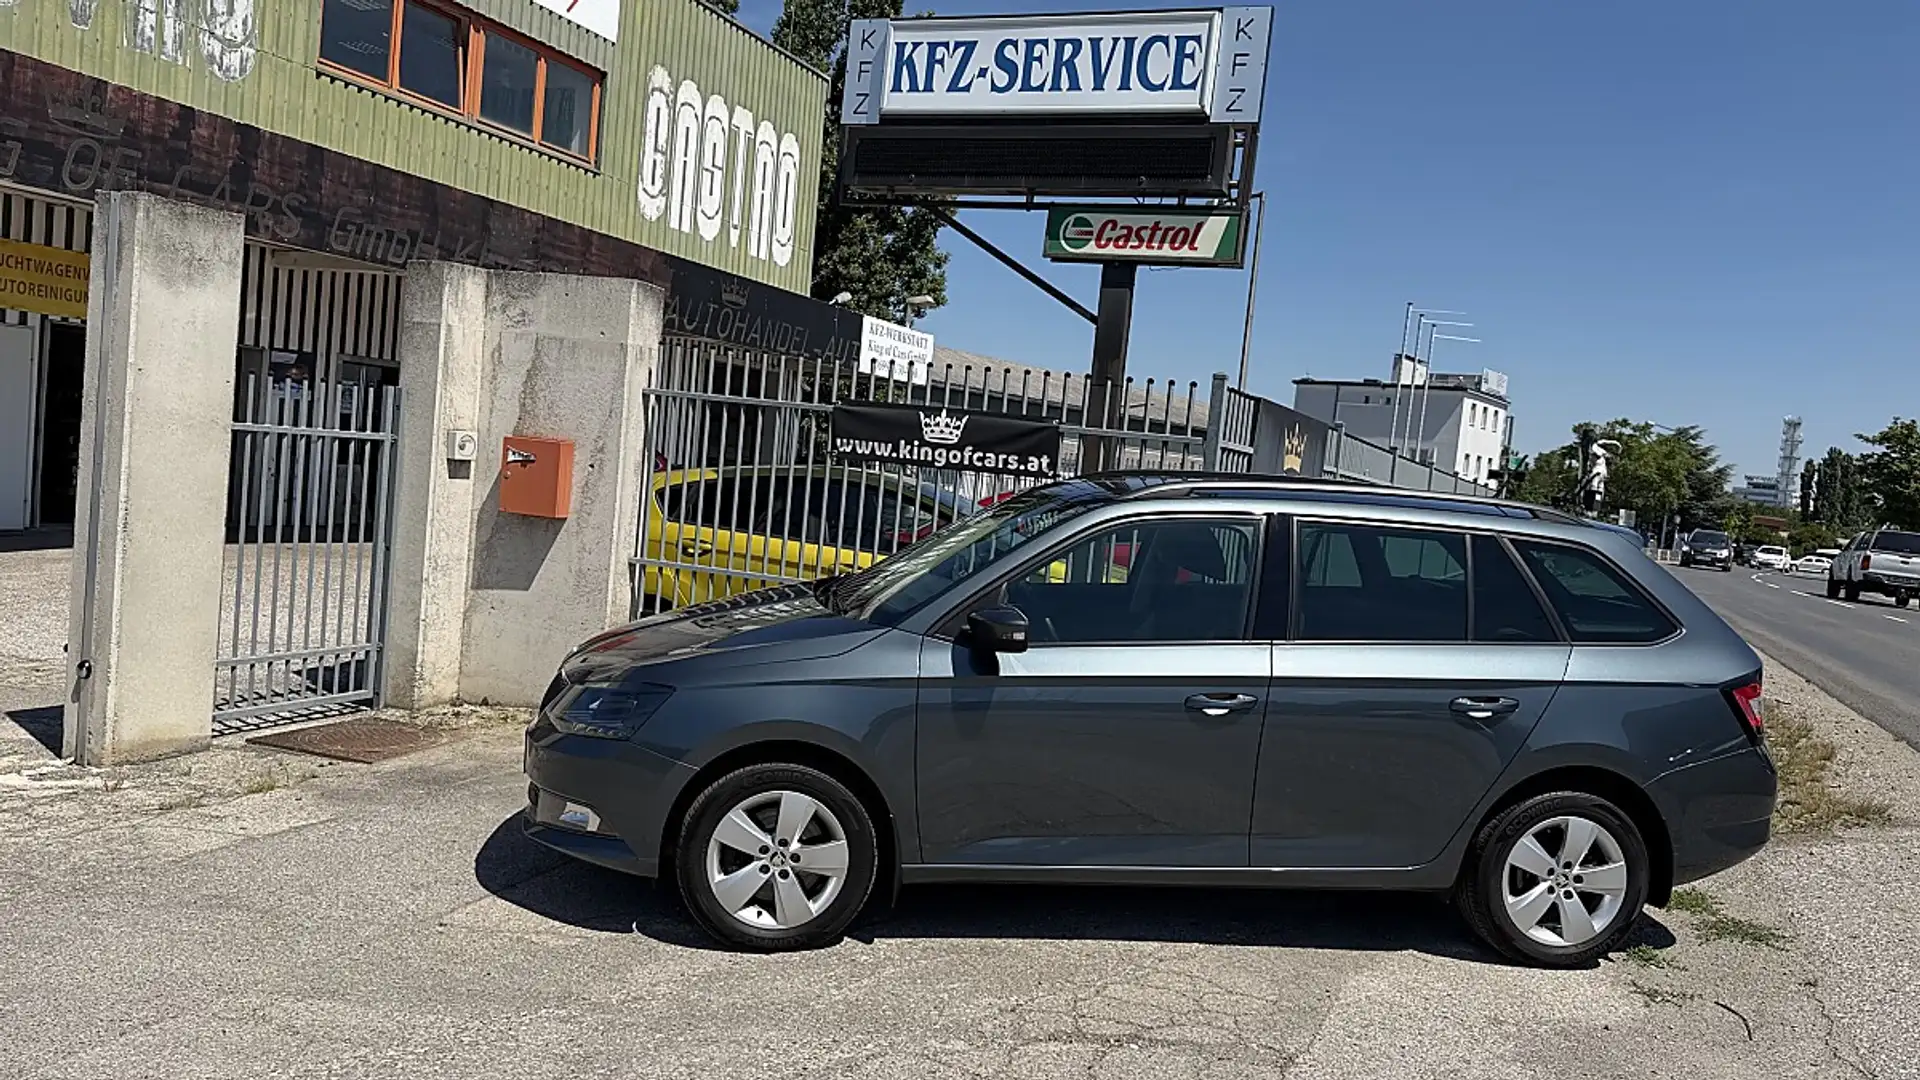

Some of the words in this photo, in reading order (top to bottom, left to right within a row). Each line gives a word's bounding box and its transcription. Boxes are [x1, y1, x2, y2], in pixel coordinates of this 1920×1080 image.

[852, 28, 877, 115] KFZ
[890, 35, 1203, 93] KFZ-SERVICE
[1225, 17, 1255, 113] KFZ
[1094, 219, 1205, 252] Castrol
[836, 437, 1052, 474] www.kingofcars.at
